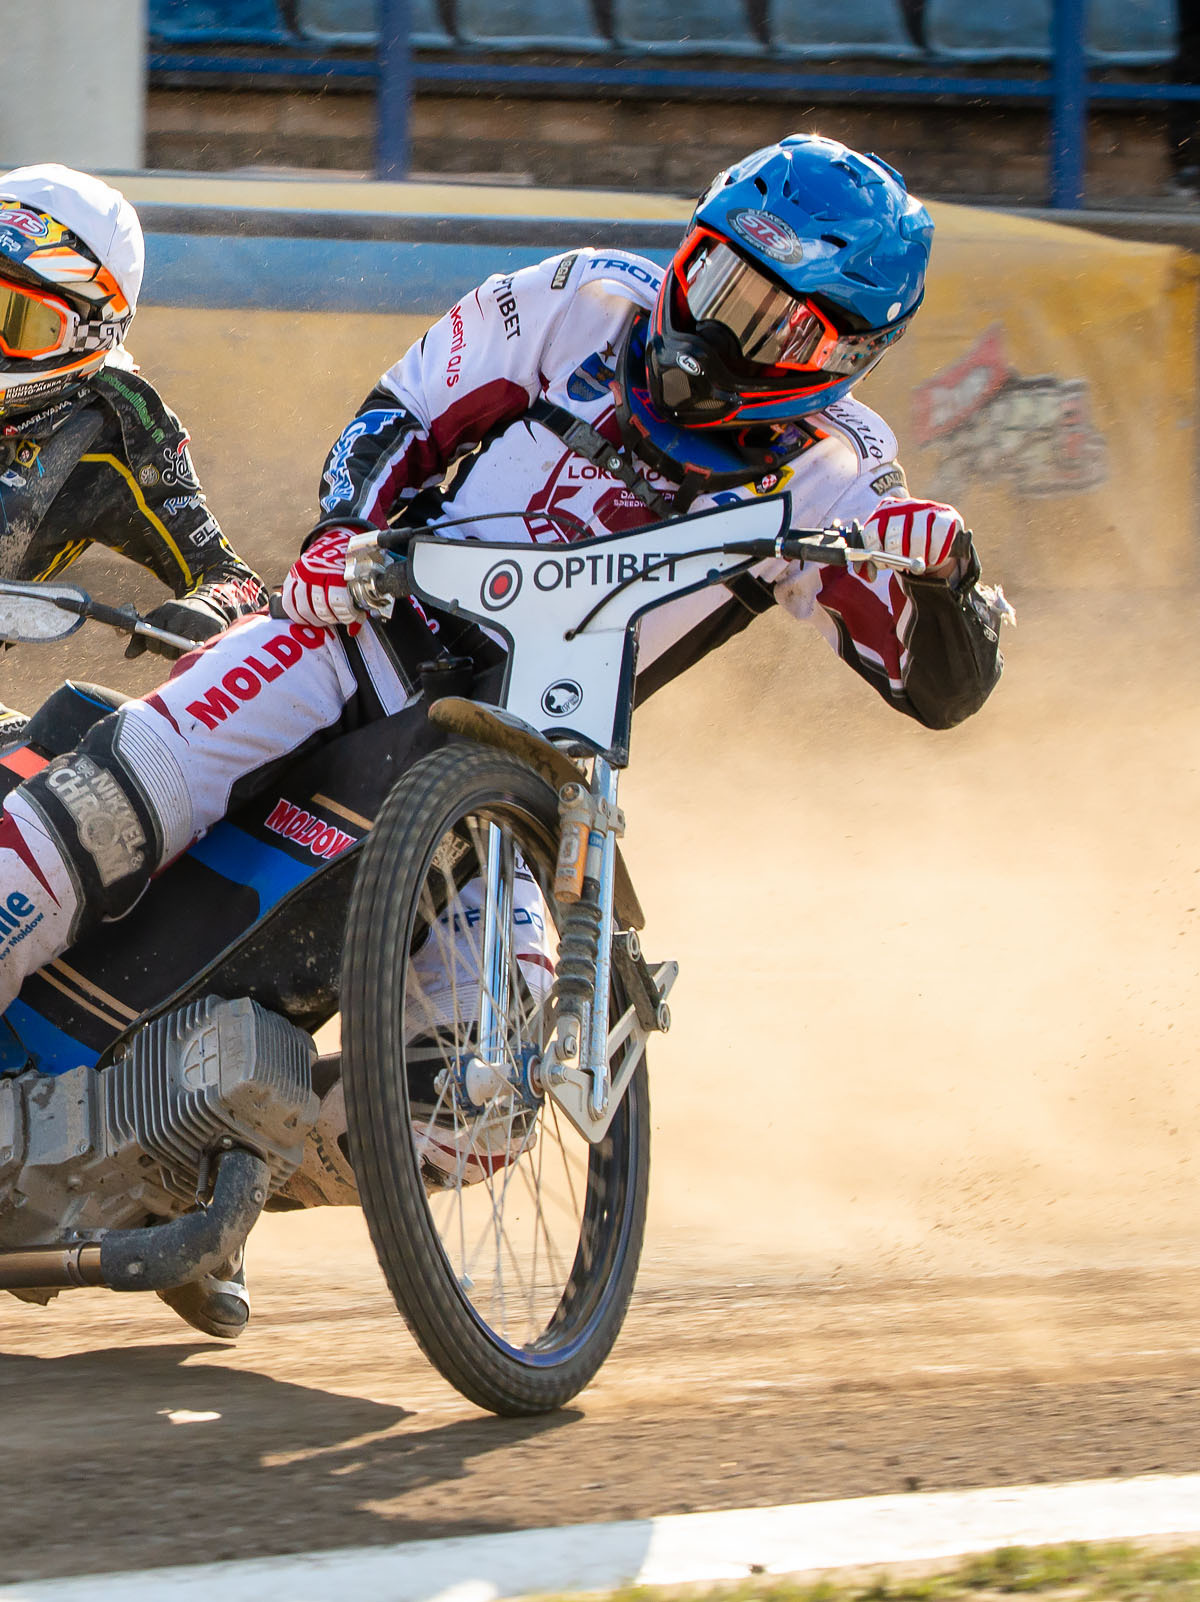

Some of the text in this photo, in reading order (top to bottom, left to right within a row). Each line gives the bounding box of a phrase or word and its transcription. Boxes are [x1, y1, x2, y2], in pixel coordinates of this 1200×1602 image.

[740, 215, 791, 250] STS
[533, 553, 684, 591] OPTIBET
[185, 623, 336, 731] MOLDO
[264, 798, 358, 859] MOLDOW
[8, 912, 45, 946] Moldow
